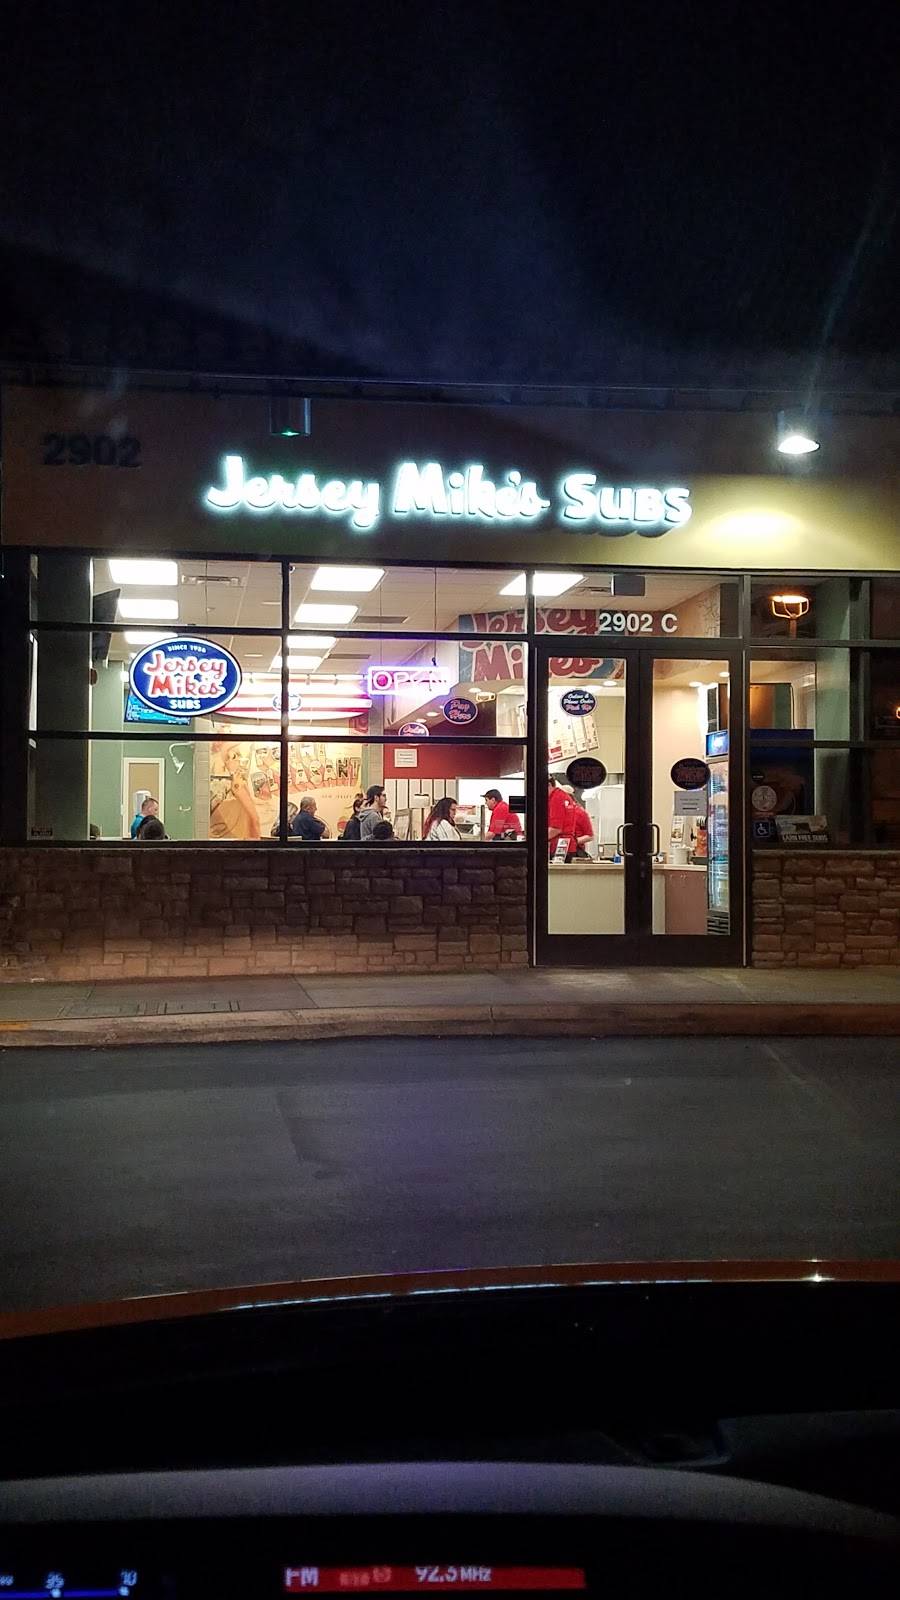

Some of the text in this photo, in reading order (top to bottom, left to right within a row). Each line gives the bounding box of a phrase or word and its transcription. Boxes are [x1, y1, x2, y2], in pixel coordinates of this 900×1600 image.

[206, 456, 380, 528] Jersey
[393, 462, 550, 518] Mike's
[599, 612, 678, 633] 2902 C
[168, 644, 188, 652] SINCE
[144, 651, 227, 680] Jersey
[168, 699, 201, 710] SUBS
